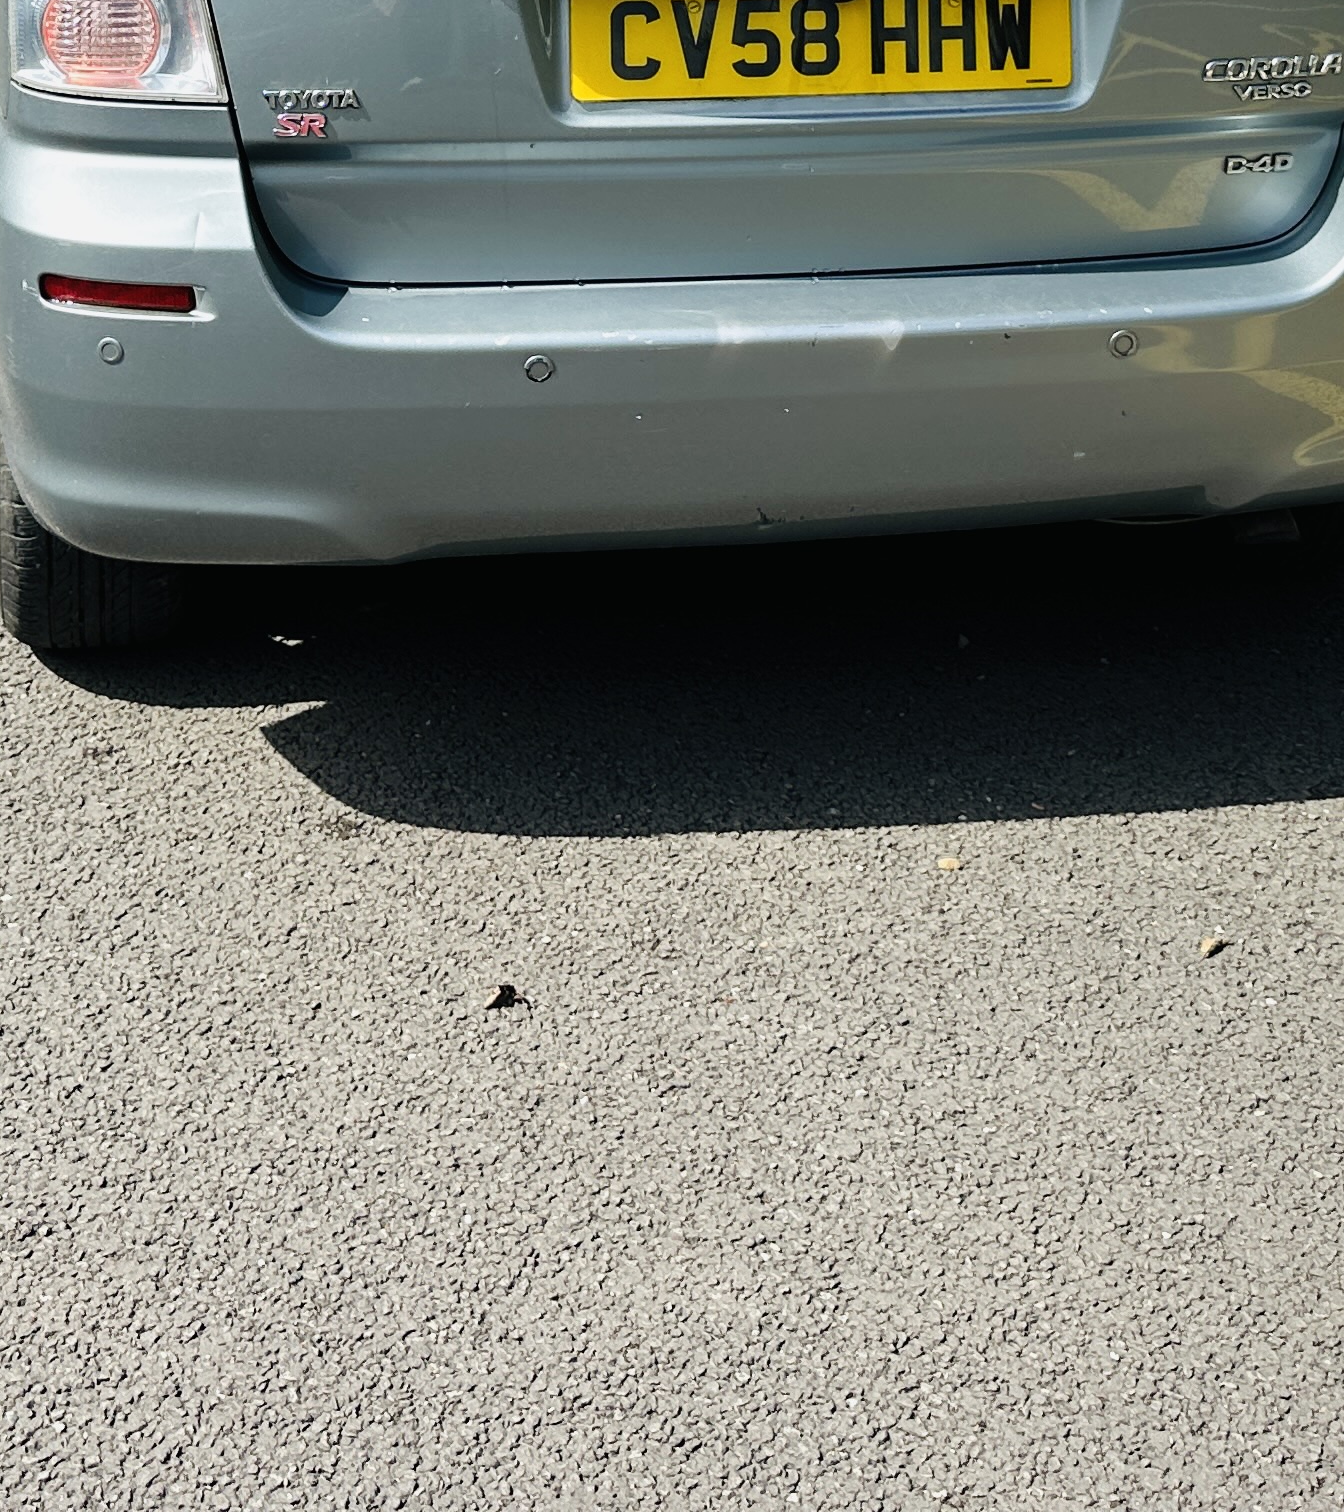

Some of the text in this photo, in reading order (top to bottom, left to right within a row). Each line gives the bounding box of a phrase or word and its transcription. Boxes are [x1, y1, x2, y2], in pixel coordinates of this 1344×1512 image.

[1203, 52, 1343, 82] COROLLA
[262, 88, 360, 109] TOYOTA
[1233, 80, 1313, 102] VERSO
[272, 112, 327, 138] SR
[1224, 152, 1294, 175] D-4D
